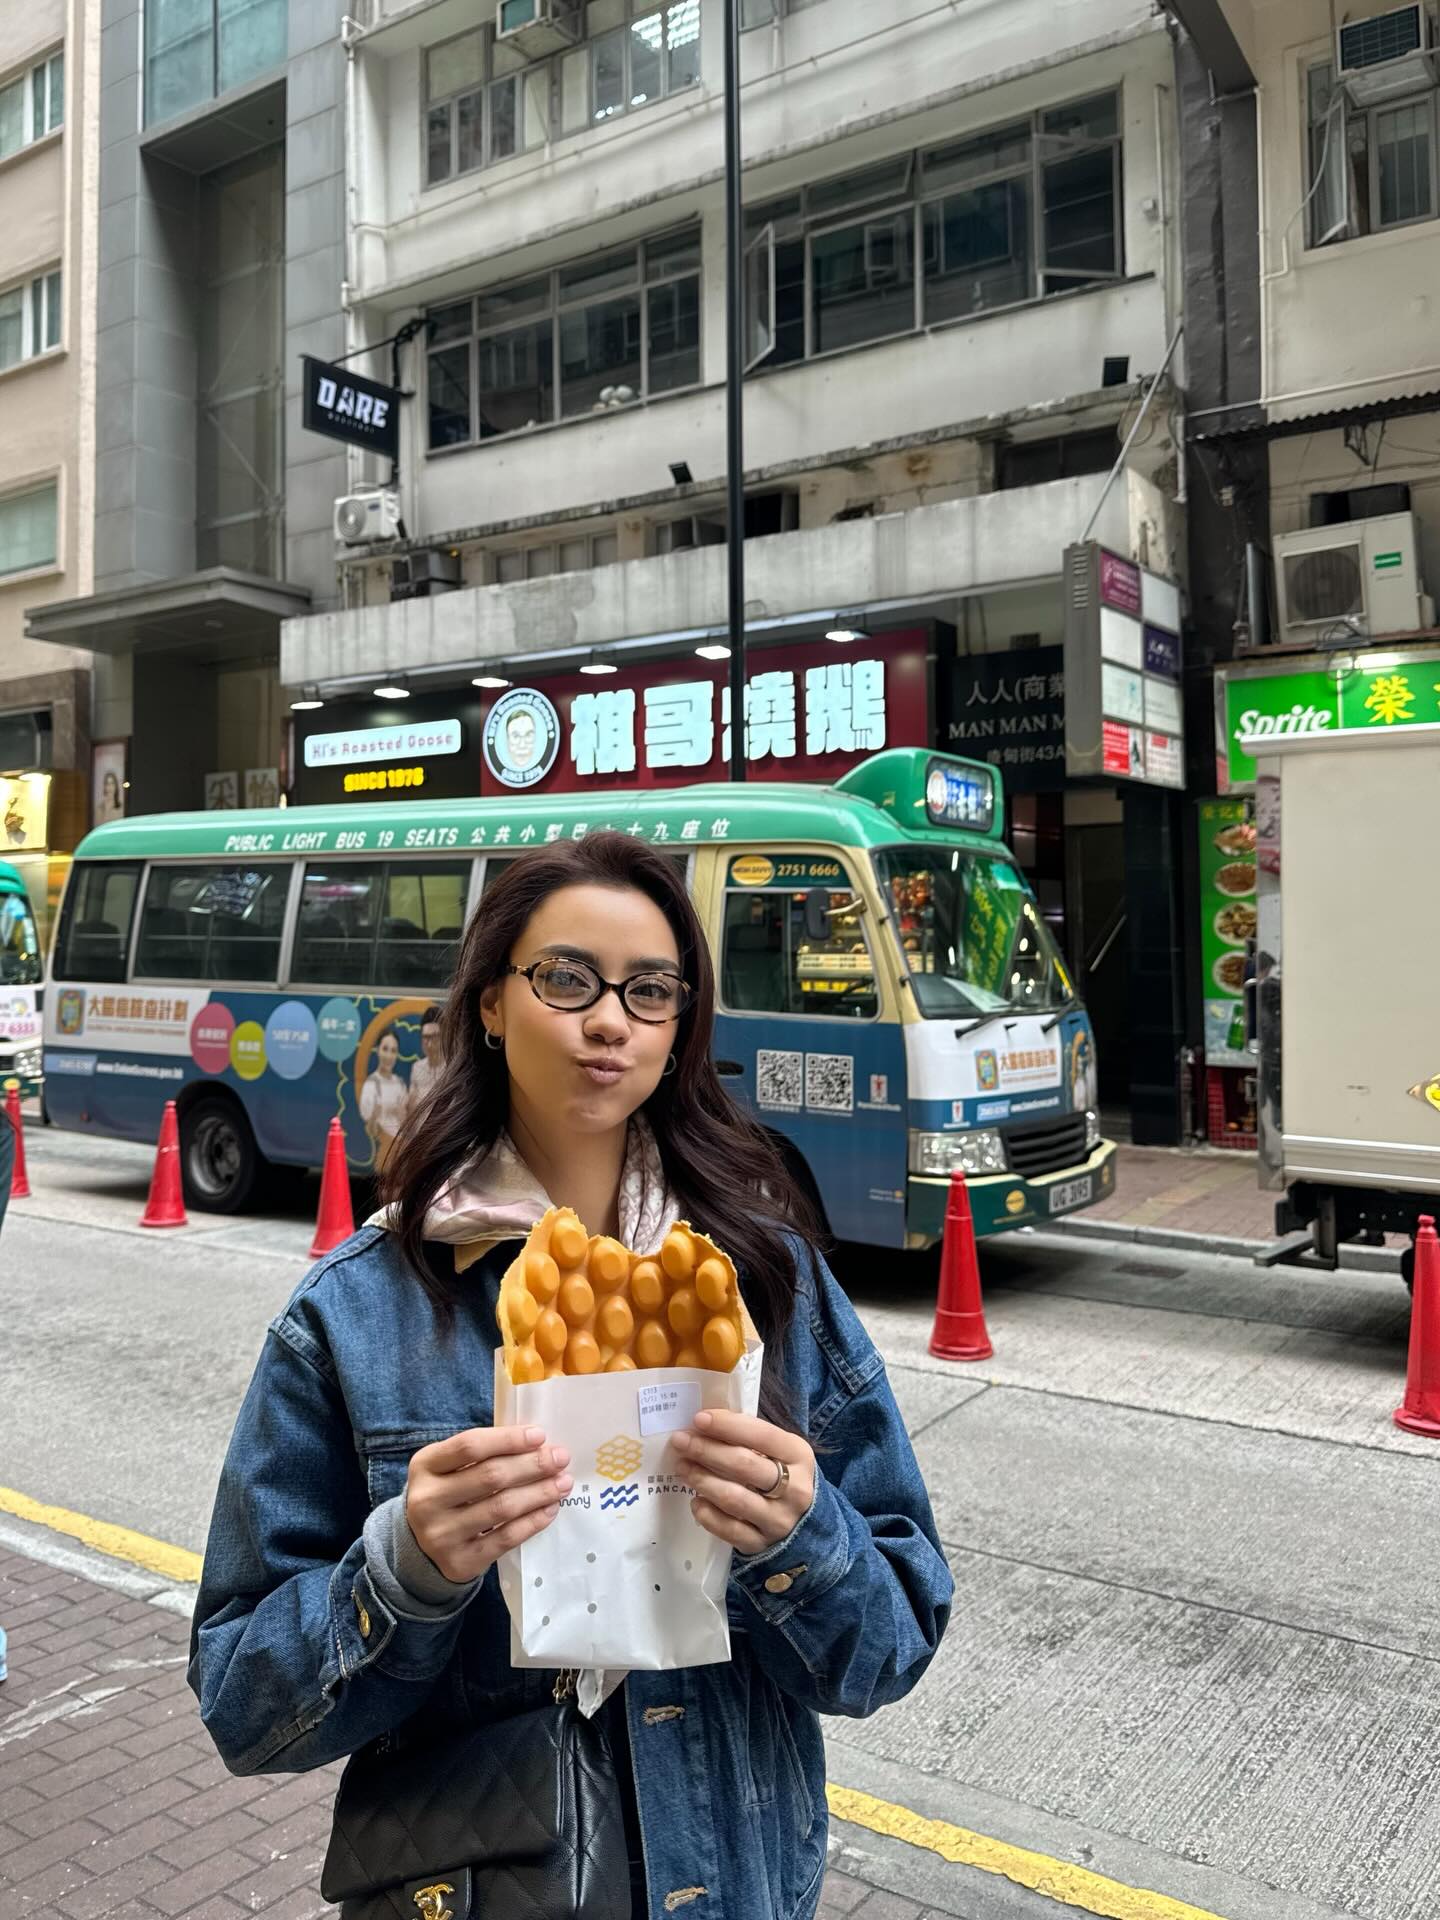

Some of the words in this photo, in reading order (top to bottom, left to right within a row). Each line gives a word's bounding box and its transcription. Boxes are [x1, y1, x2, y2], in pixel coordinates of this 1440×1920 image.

[317, 376, 389, 429] DARE
[570, 659, 886, 775] 祺哥燒鵝
[948, 719, 995, 739] MAN
[1000, 714, 1047, 735] MAN
[1234, 704, 1333, 740] Sprite
[342, 735, 403, 756] Roasted
[408, 733, 454, 749] Goose
[344, 771, 387, 792] SINCE
[224, 834, 274, 851] PUBLIC
[282, 832, 327, 850] LIGHT
[335, 831, 367, 849] BUS
[377, 830, 394, 847] 19
[404, 828, 459, 846] SEATS
[471, 818, 731, 843] 公共小型巴十九座位
[777, 863, 806, 877] 2751
[809, 863, 840, 877] 6666
[647, 1486, 697, 1497] PANCAK
